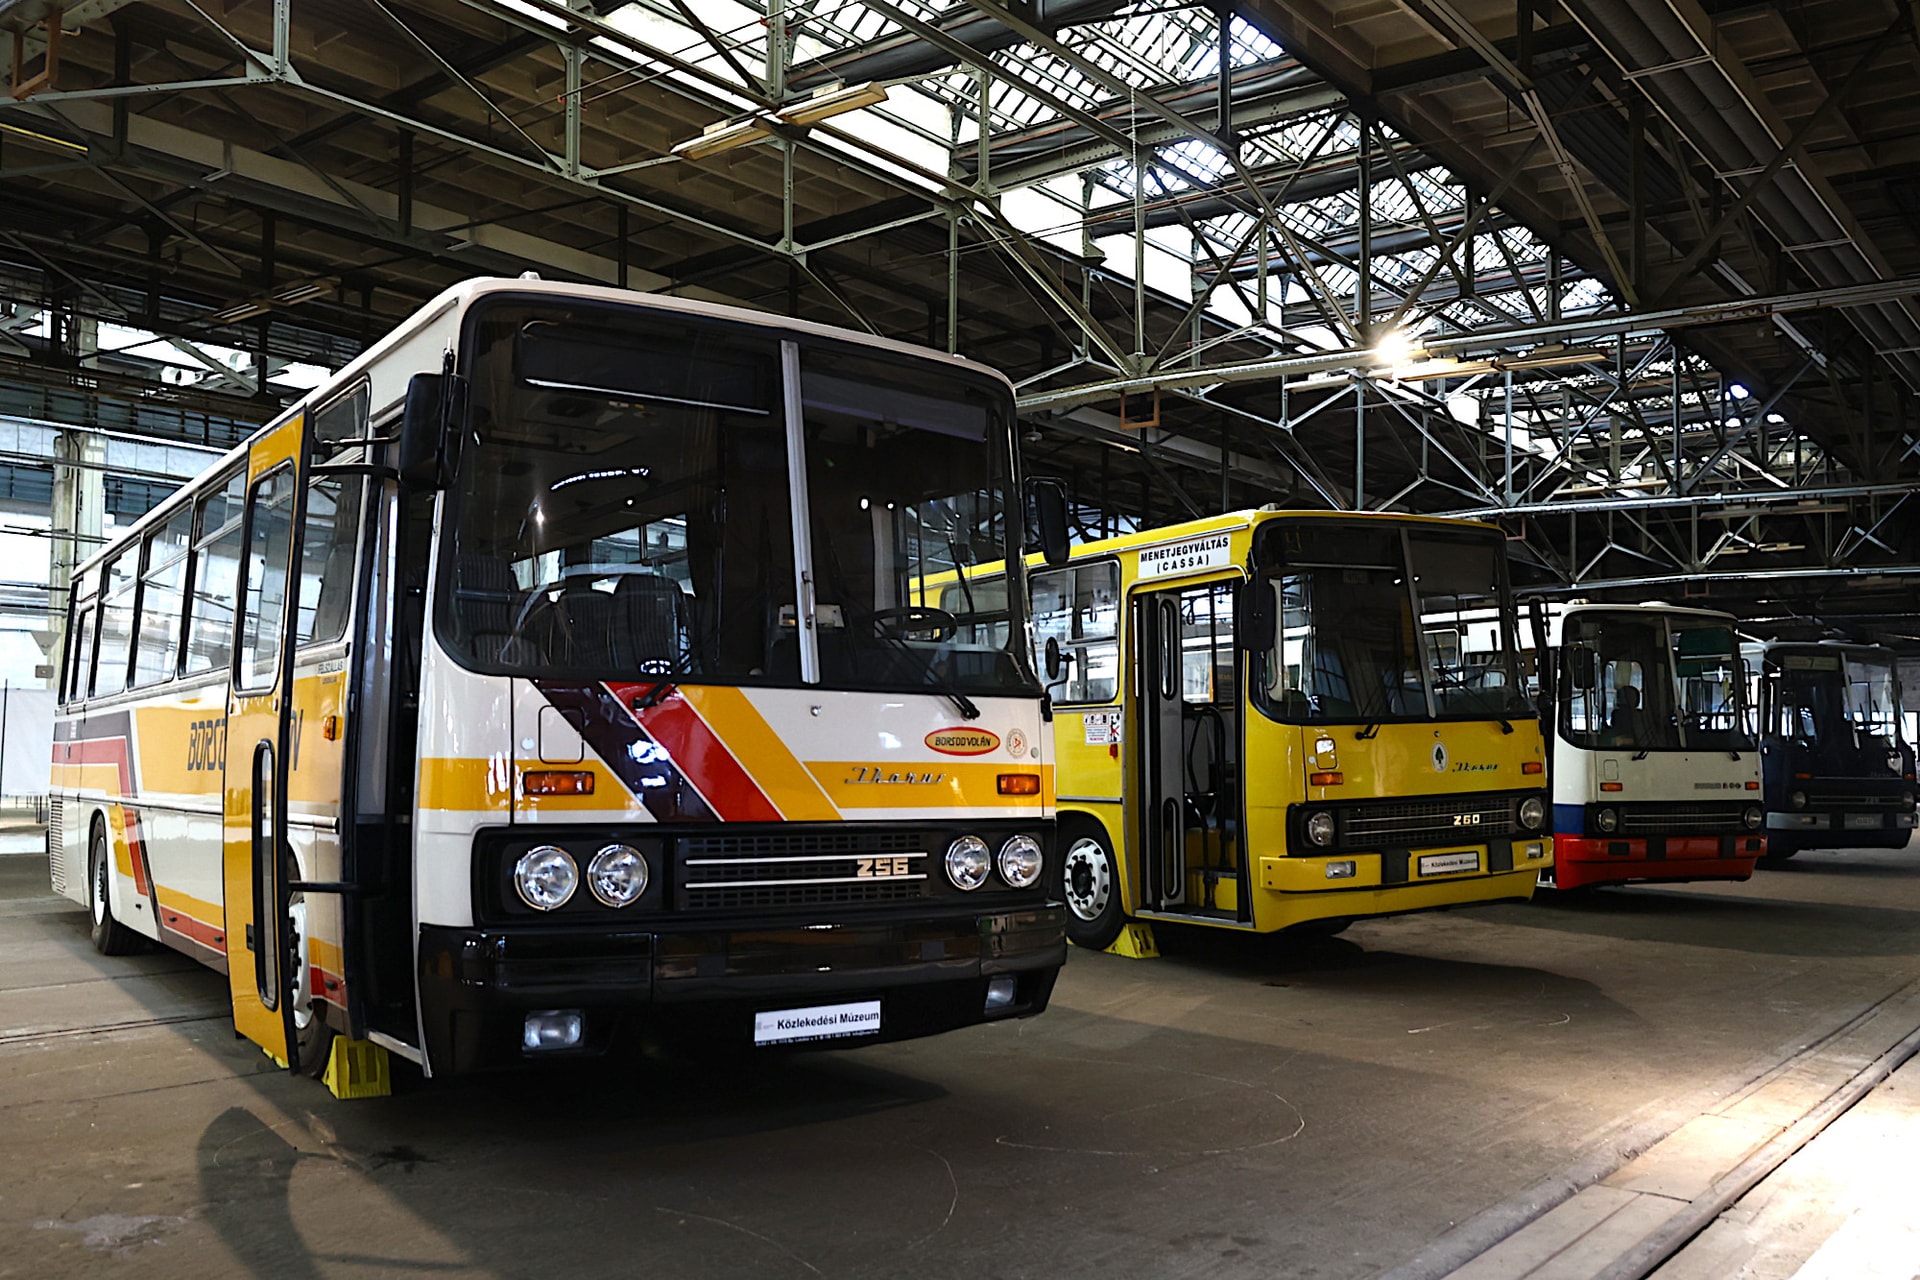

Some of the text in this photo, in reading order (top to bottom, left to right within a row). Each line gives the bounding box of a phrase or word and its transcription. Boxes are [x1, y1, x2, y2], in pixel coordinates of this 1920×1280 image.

[1140, 536, 1228, 562] MENETJEGYVÁLTÁS
[1156, 554, 1209, 573] (CASSA)
[844, 766, 947, 785] Ikarus
[1453, 813, 1480, 826] 260
[857, 857, 909, 877] 256
[777, 1012, 879, 1030] Közlekedési Múzeum
